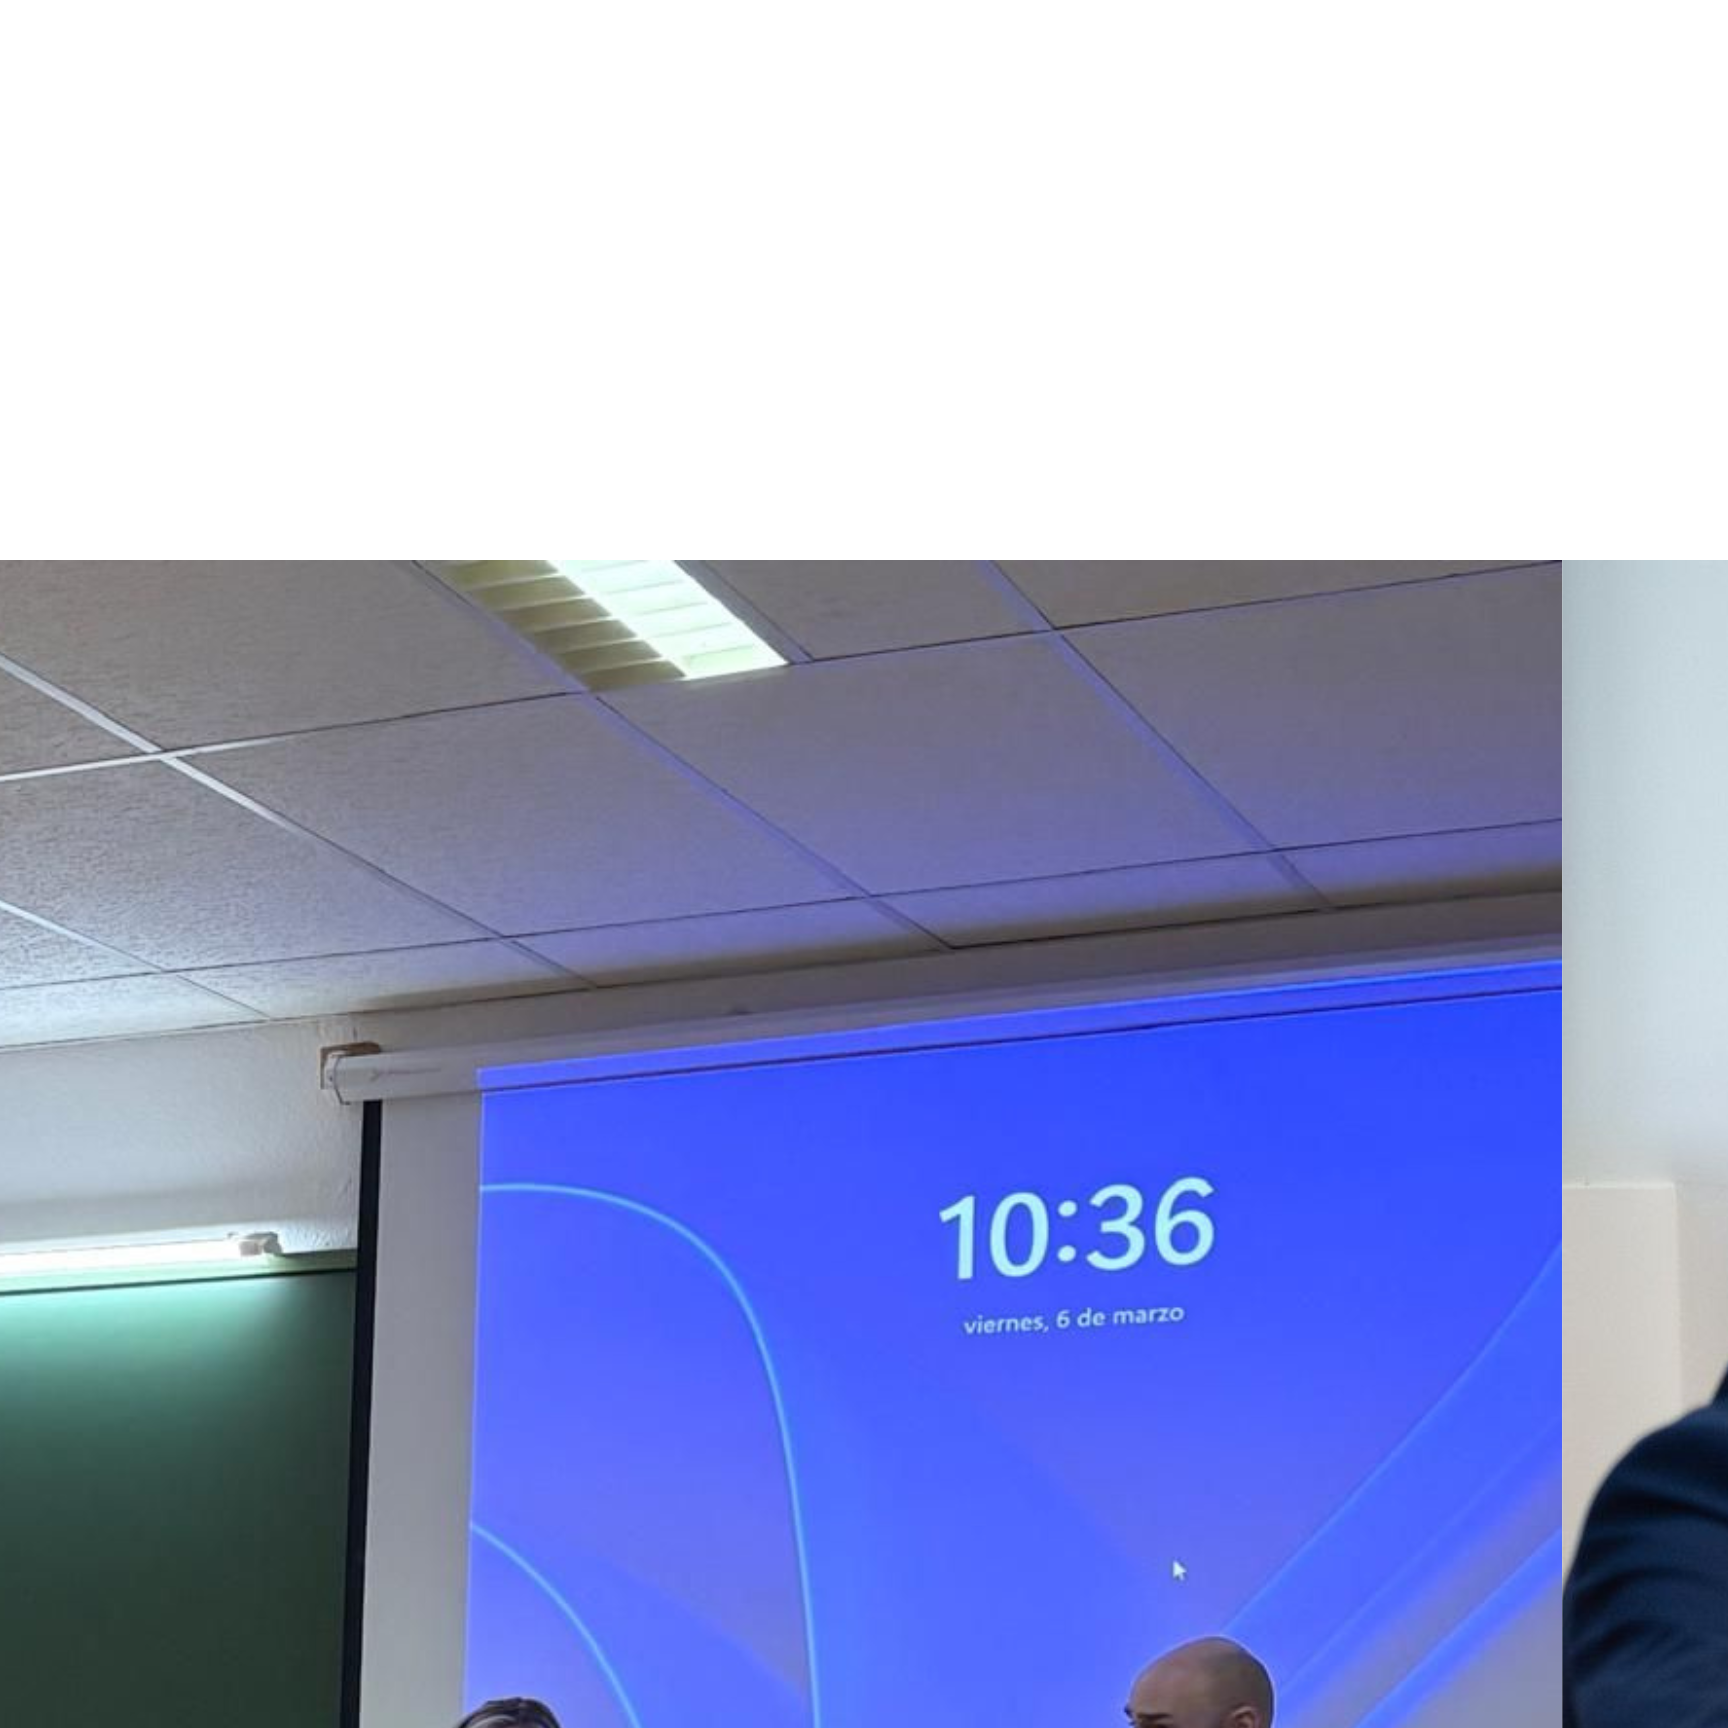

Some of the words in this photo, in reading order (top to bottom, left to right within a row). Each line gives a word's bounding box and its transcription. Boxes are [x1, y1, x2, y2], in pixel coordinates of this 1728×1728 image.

[938, 1176, 1215, 1280] 10:36
[964, 1314, 1049, 1334] viernes,
[1056, 1309, 1071, 1329] 6
[1076, 1307, 1106, 1328] de
[1113, 1306, 1185, 1325] marzo
